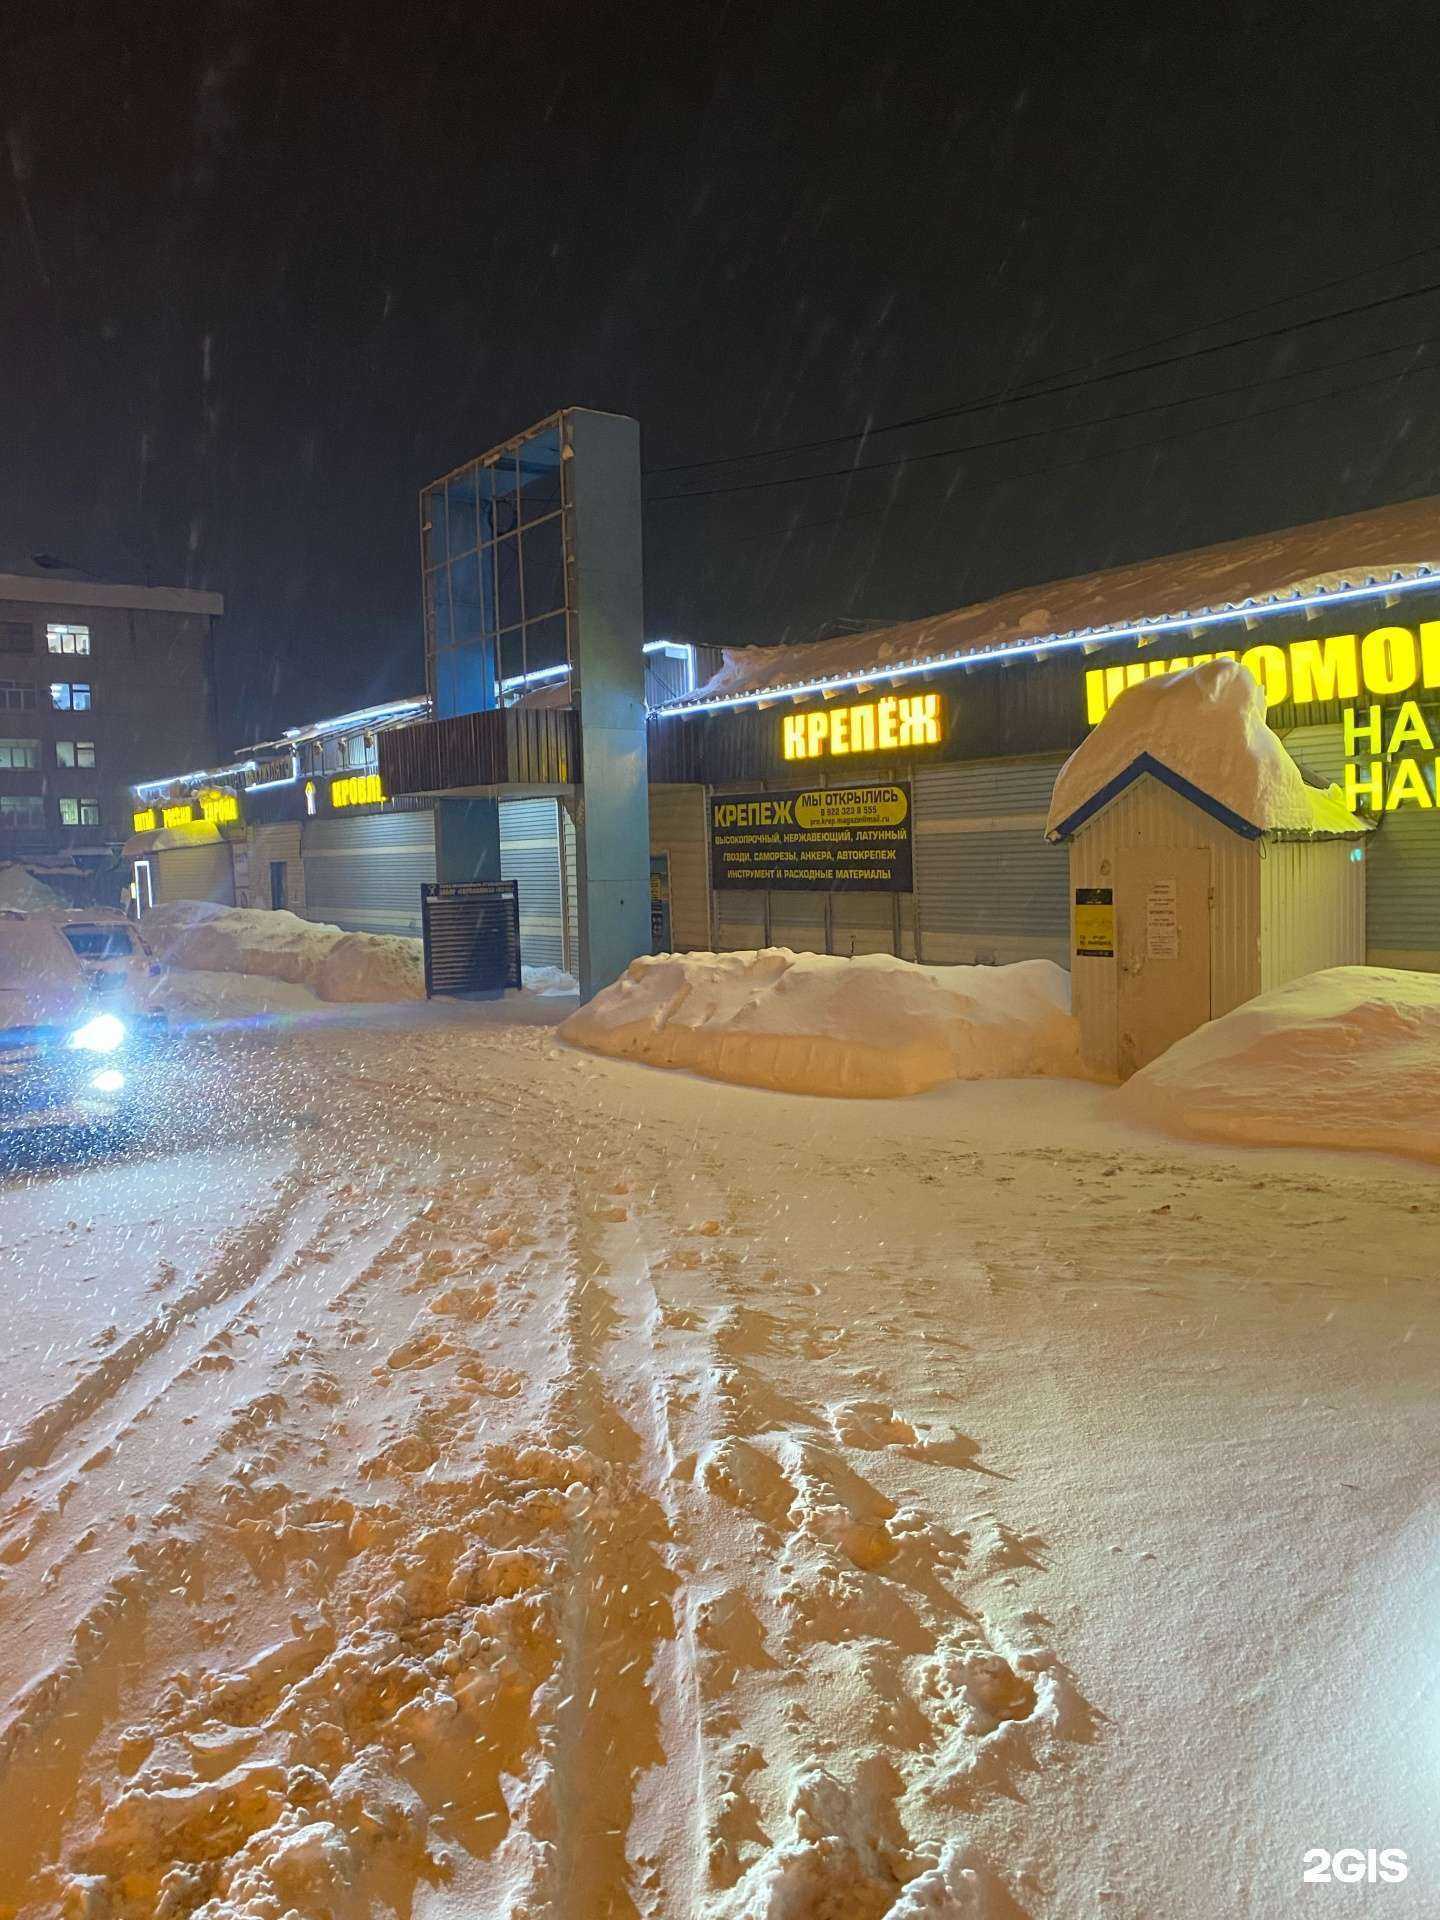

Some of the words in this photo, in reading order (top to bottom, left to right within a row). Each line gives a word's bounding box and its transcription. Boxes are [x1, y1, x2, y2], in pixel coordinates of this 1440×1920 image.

[782, 694, 942, 761] КРЕПЁЖ
[1344, 756, 1440, 812] НА
[801, 794, 822, 807] МЫ
[825, 789, 899, 805] ОТКРЫЛИСЬ
[864, 806, 877, 814] 555
[783, 830, 853, 843] НЕРЖАВЕЮЩИЙ,
[855, 828, 907, 841] ЛАТУННЫЙ
[723, 851, 752, 862] ГВОЗДИ,
[754, 850, 797, 861] САМОРЕЗЫ,
[800, 850, 834, 861] АНКЕРА,
[836, 849, 897, 860] АВТОКРЕПЕЖ
[727, 869, 775, 879] ИНСТРУМЕНТ
[776, 869, 782, 879] И
[784, 869, 833, 880] РАСХОДНЫЕ
[835, 868, 892, 879] МАТЕРИАЛЫ
